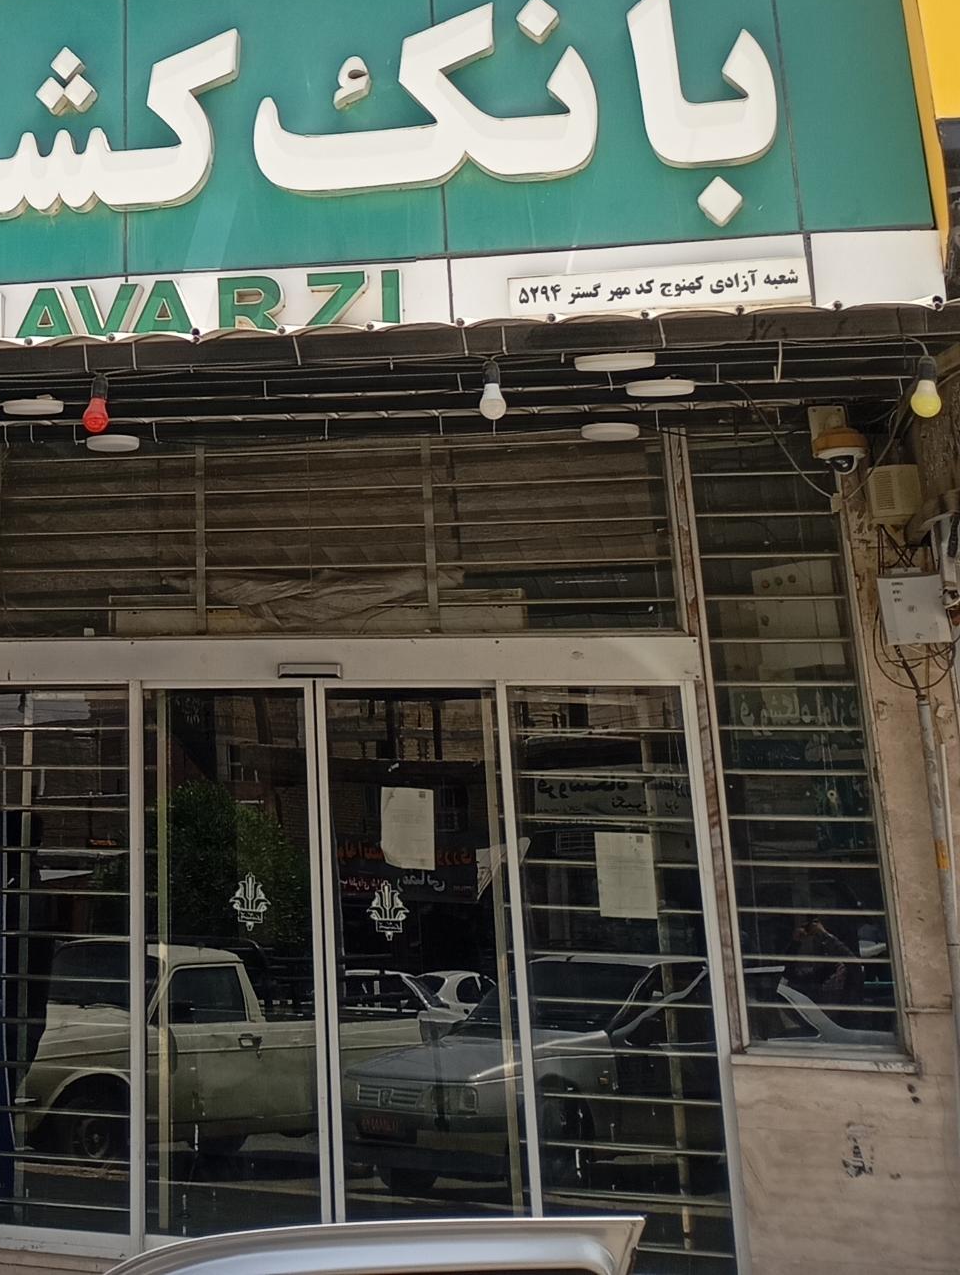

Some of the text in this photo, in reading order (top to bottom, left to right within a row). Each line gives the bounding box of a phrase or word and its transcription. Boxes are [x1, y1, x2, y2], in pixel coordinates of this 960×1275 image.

[518, 269, 799, 305] شعبه آزادی کهنوج کد مهر گستر ۵۲۹۴
